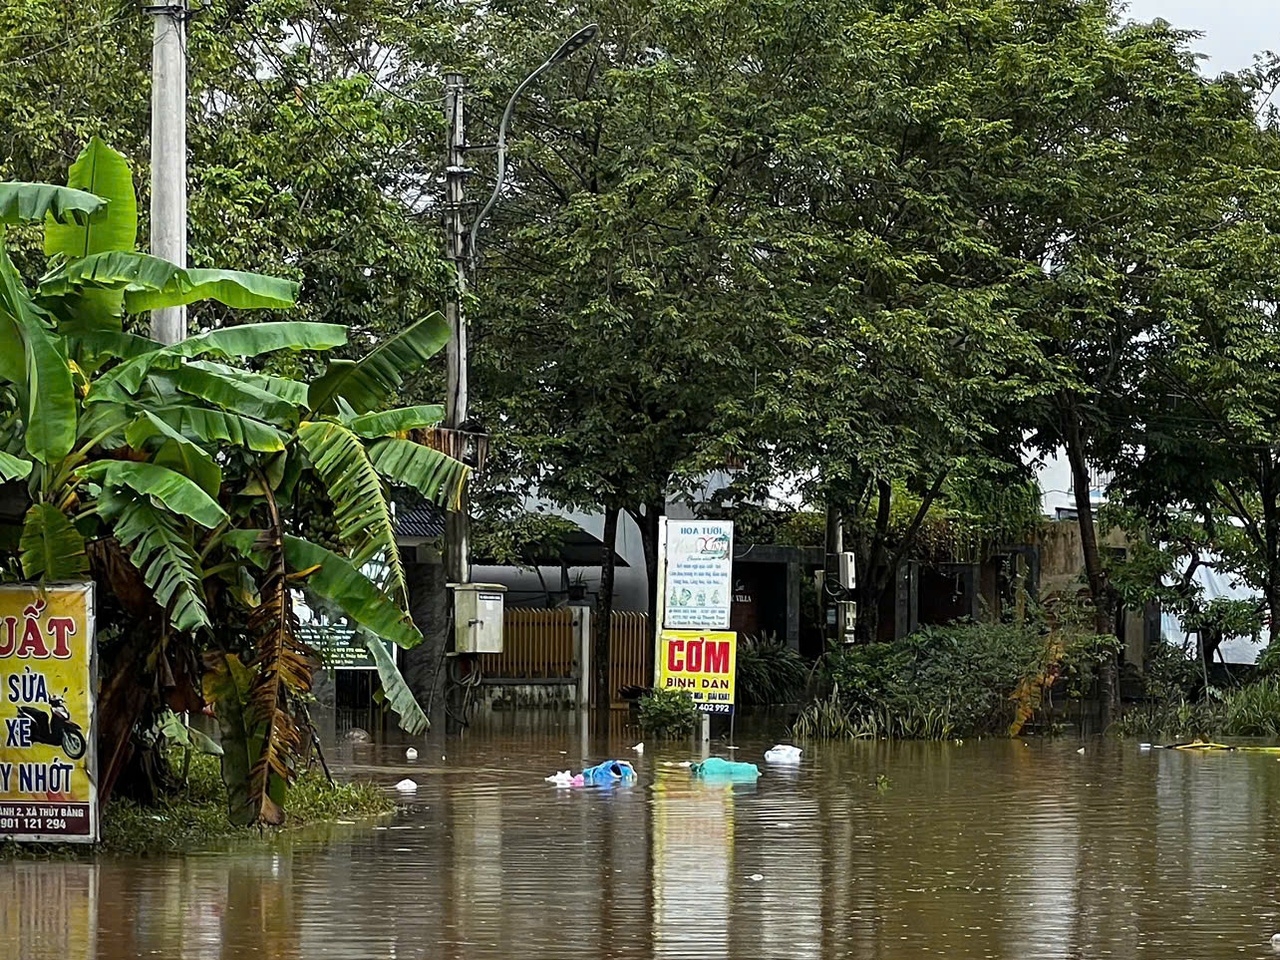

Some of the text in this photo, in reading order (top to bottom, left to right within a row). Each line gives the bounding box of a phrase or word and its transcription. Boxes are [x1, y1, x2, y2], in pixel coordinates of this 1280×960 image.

[680, 527, 699, 535] HOA
[668, 637, 730, 673] CƠM
[8, 665, 48, 703] SỬA
[698, 703, 714, 711] 402
[714, 704, 730, 713] 992
[5, 719, 31, 747] XE
[20, 757, 73, 792] NHỚT
[24, 818, 42, 829] 121
[46, 818, 66, 830] 294
